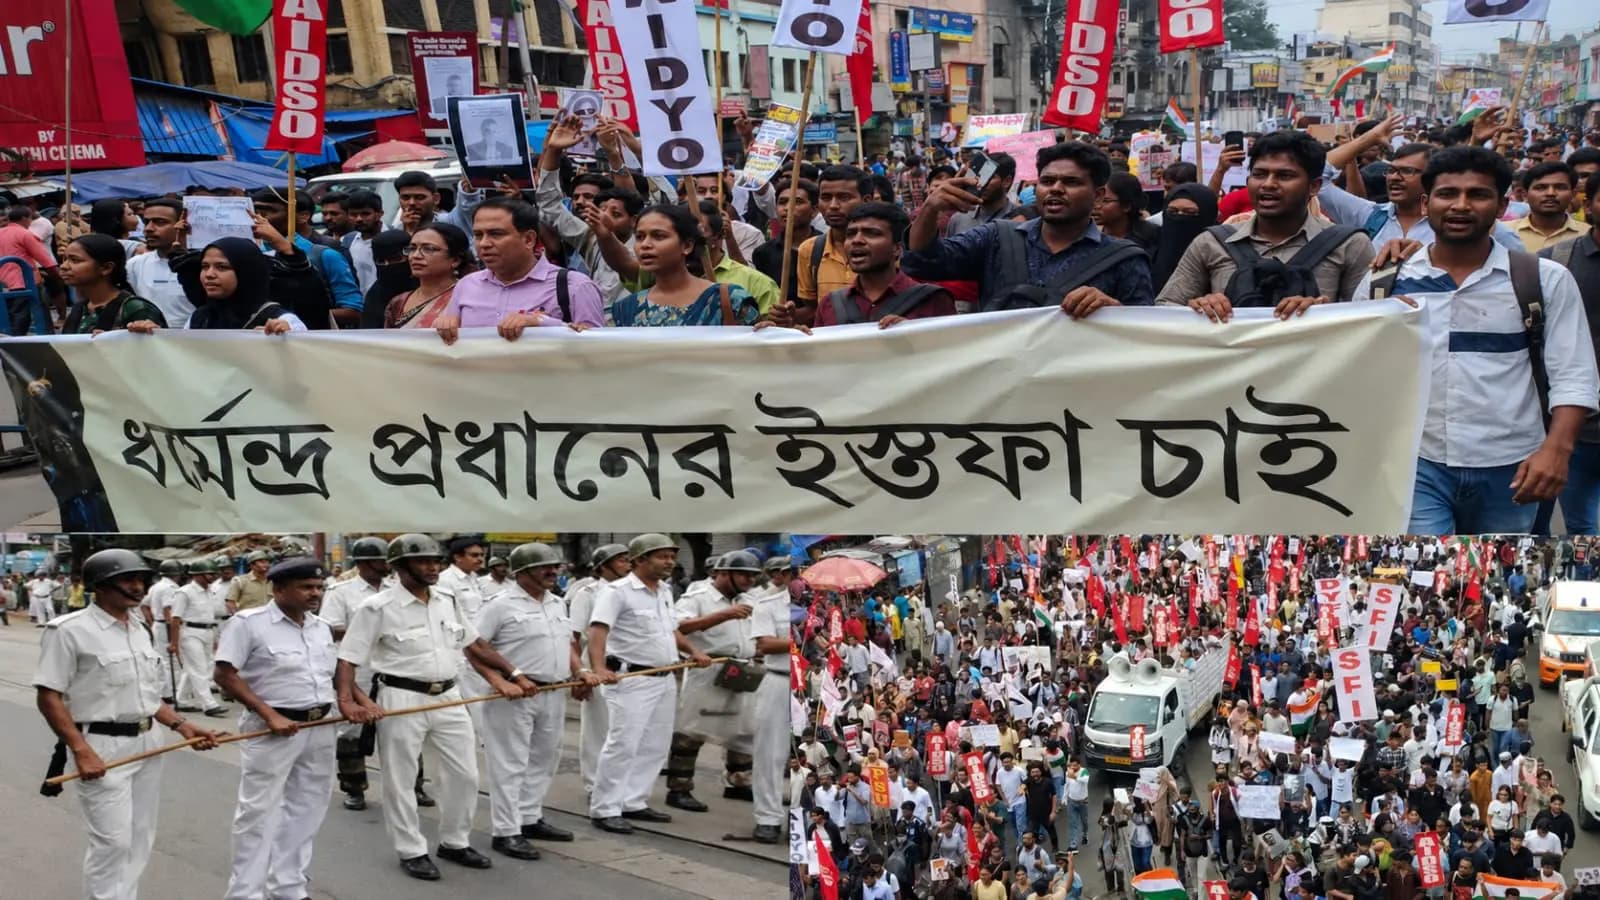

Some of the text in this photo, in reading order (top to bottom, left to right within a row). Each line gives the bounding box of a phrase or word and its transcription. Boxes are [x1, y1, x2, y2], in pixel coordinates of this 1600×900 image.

[279, 0, 323, 139] AIDSO
[586, 0, 631, 121] AIDSO
[625, 0, 704, 170] IDYO
[37, 130, 55, 143] BY
[121, 385, 1353, 518] ধর্মেন্দ্র প্রধানের ইস্তফা চাই
[1368, 588, 1393, 647] SFI
[1338, 651, 1362, 718] SFI
[967, 755, 989, 799] AIDSO
[1418, 836, 1440, 884] AIDSO
